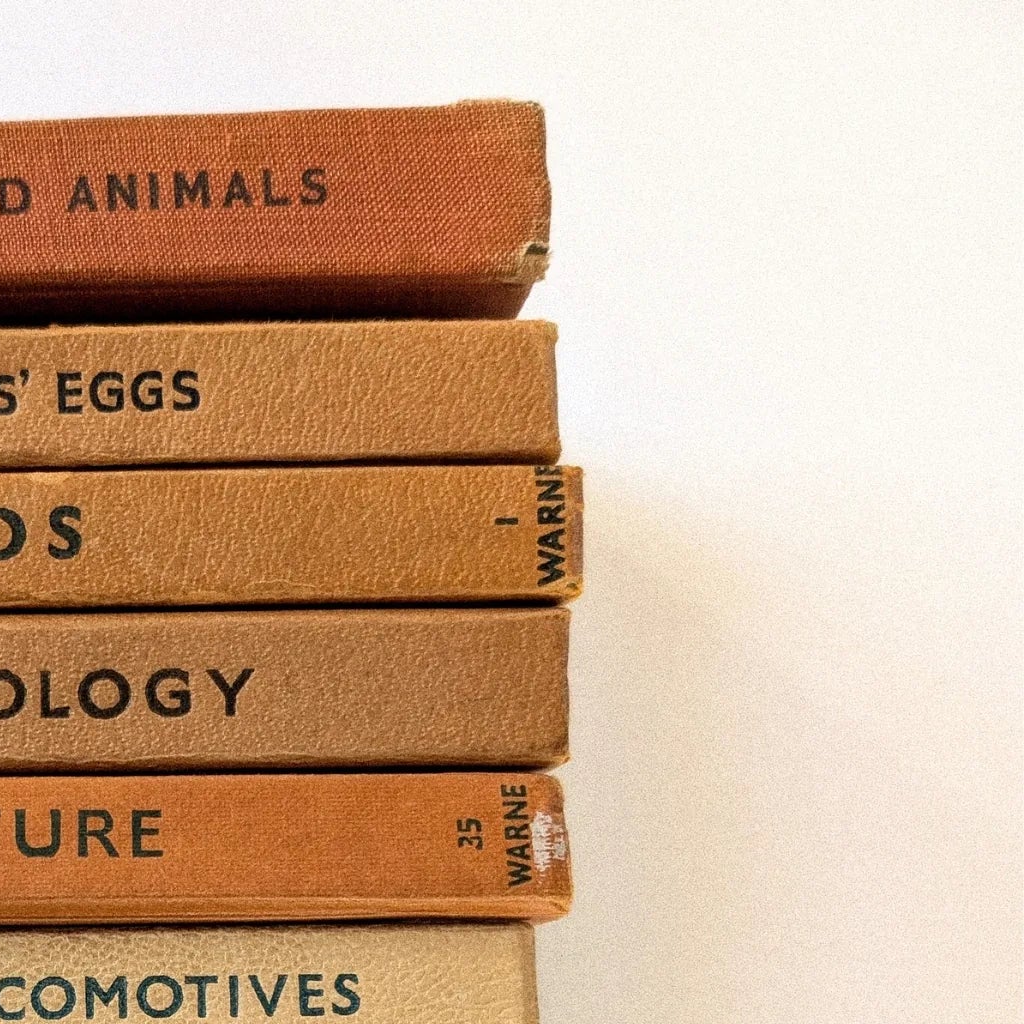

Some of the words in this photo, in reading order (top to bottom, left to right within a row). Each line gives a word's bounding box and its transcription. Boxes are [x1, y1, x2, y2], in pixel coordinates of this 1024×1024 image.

[67, 168, 328, 212] ANIMALS
[56, 370, 201, 414] EGGS
[457, 817, 483, 850] 35
[500, 783, 532, 888] WARNE
